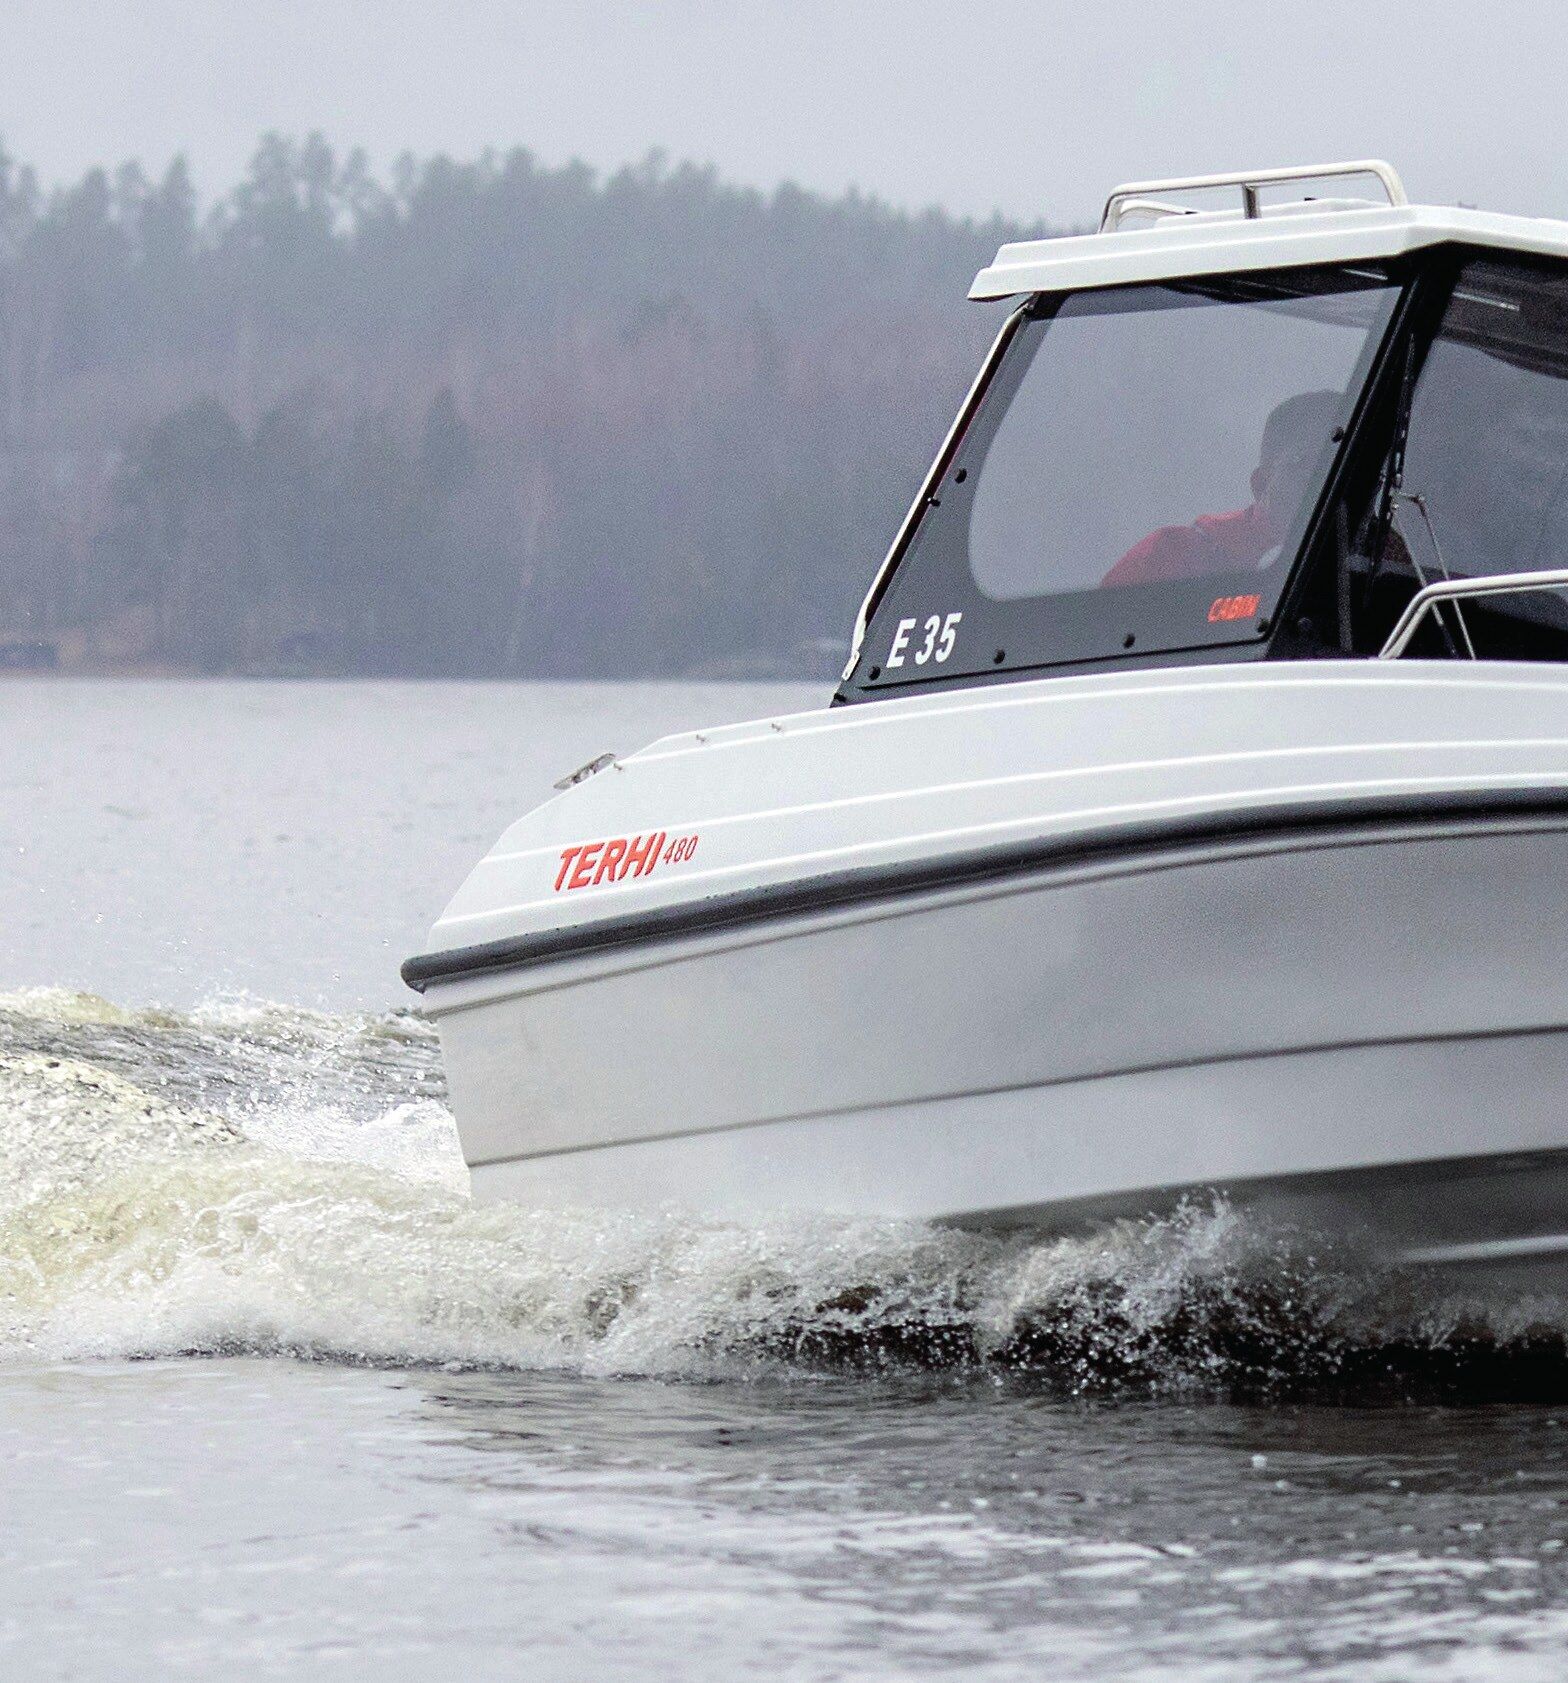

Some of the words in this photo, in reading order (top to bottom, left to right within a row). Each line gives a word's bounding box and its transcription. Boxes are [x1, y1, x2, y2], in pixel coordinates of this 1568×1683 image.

[1206, 593, 1261, 624] CABIN
[885, 618, 917, 669] E
[914, 612, 963, 665] 35
[554, 831, 667, 891] TERHI
[663, 834, 699, 865] 480
